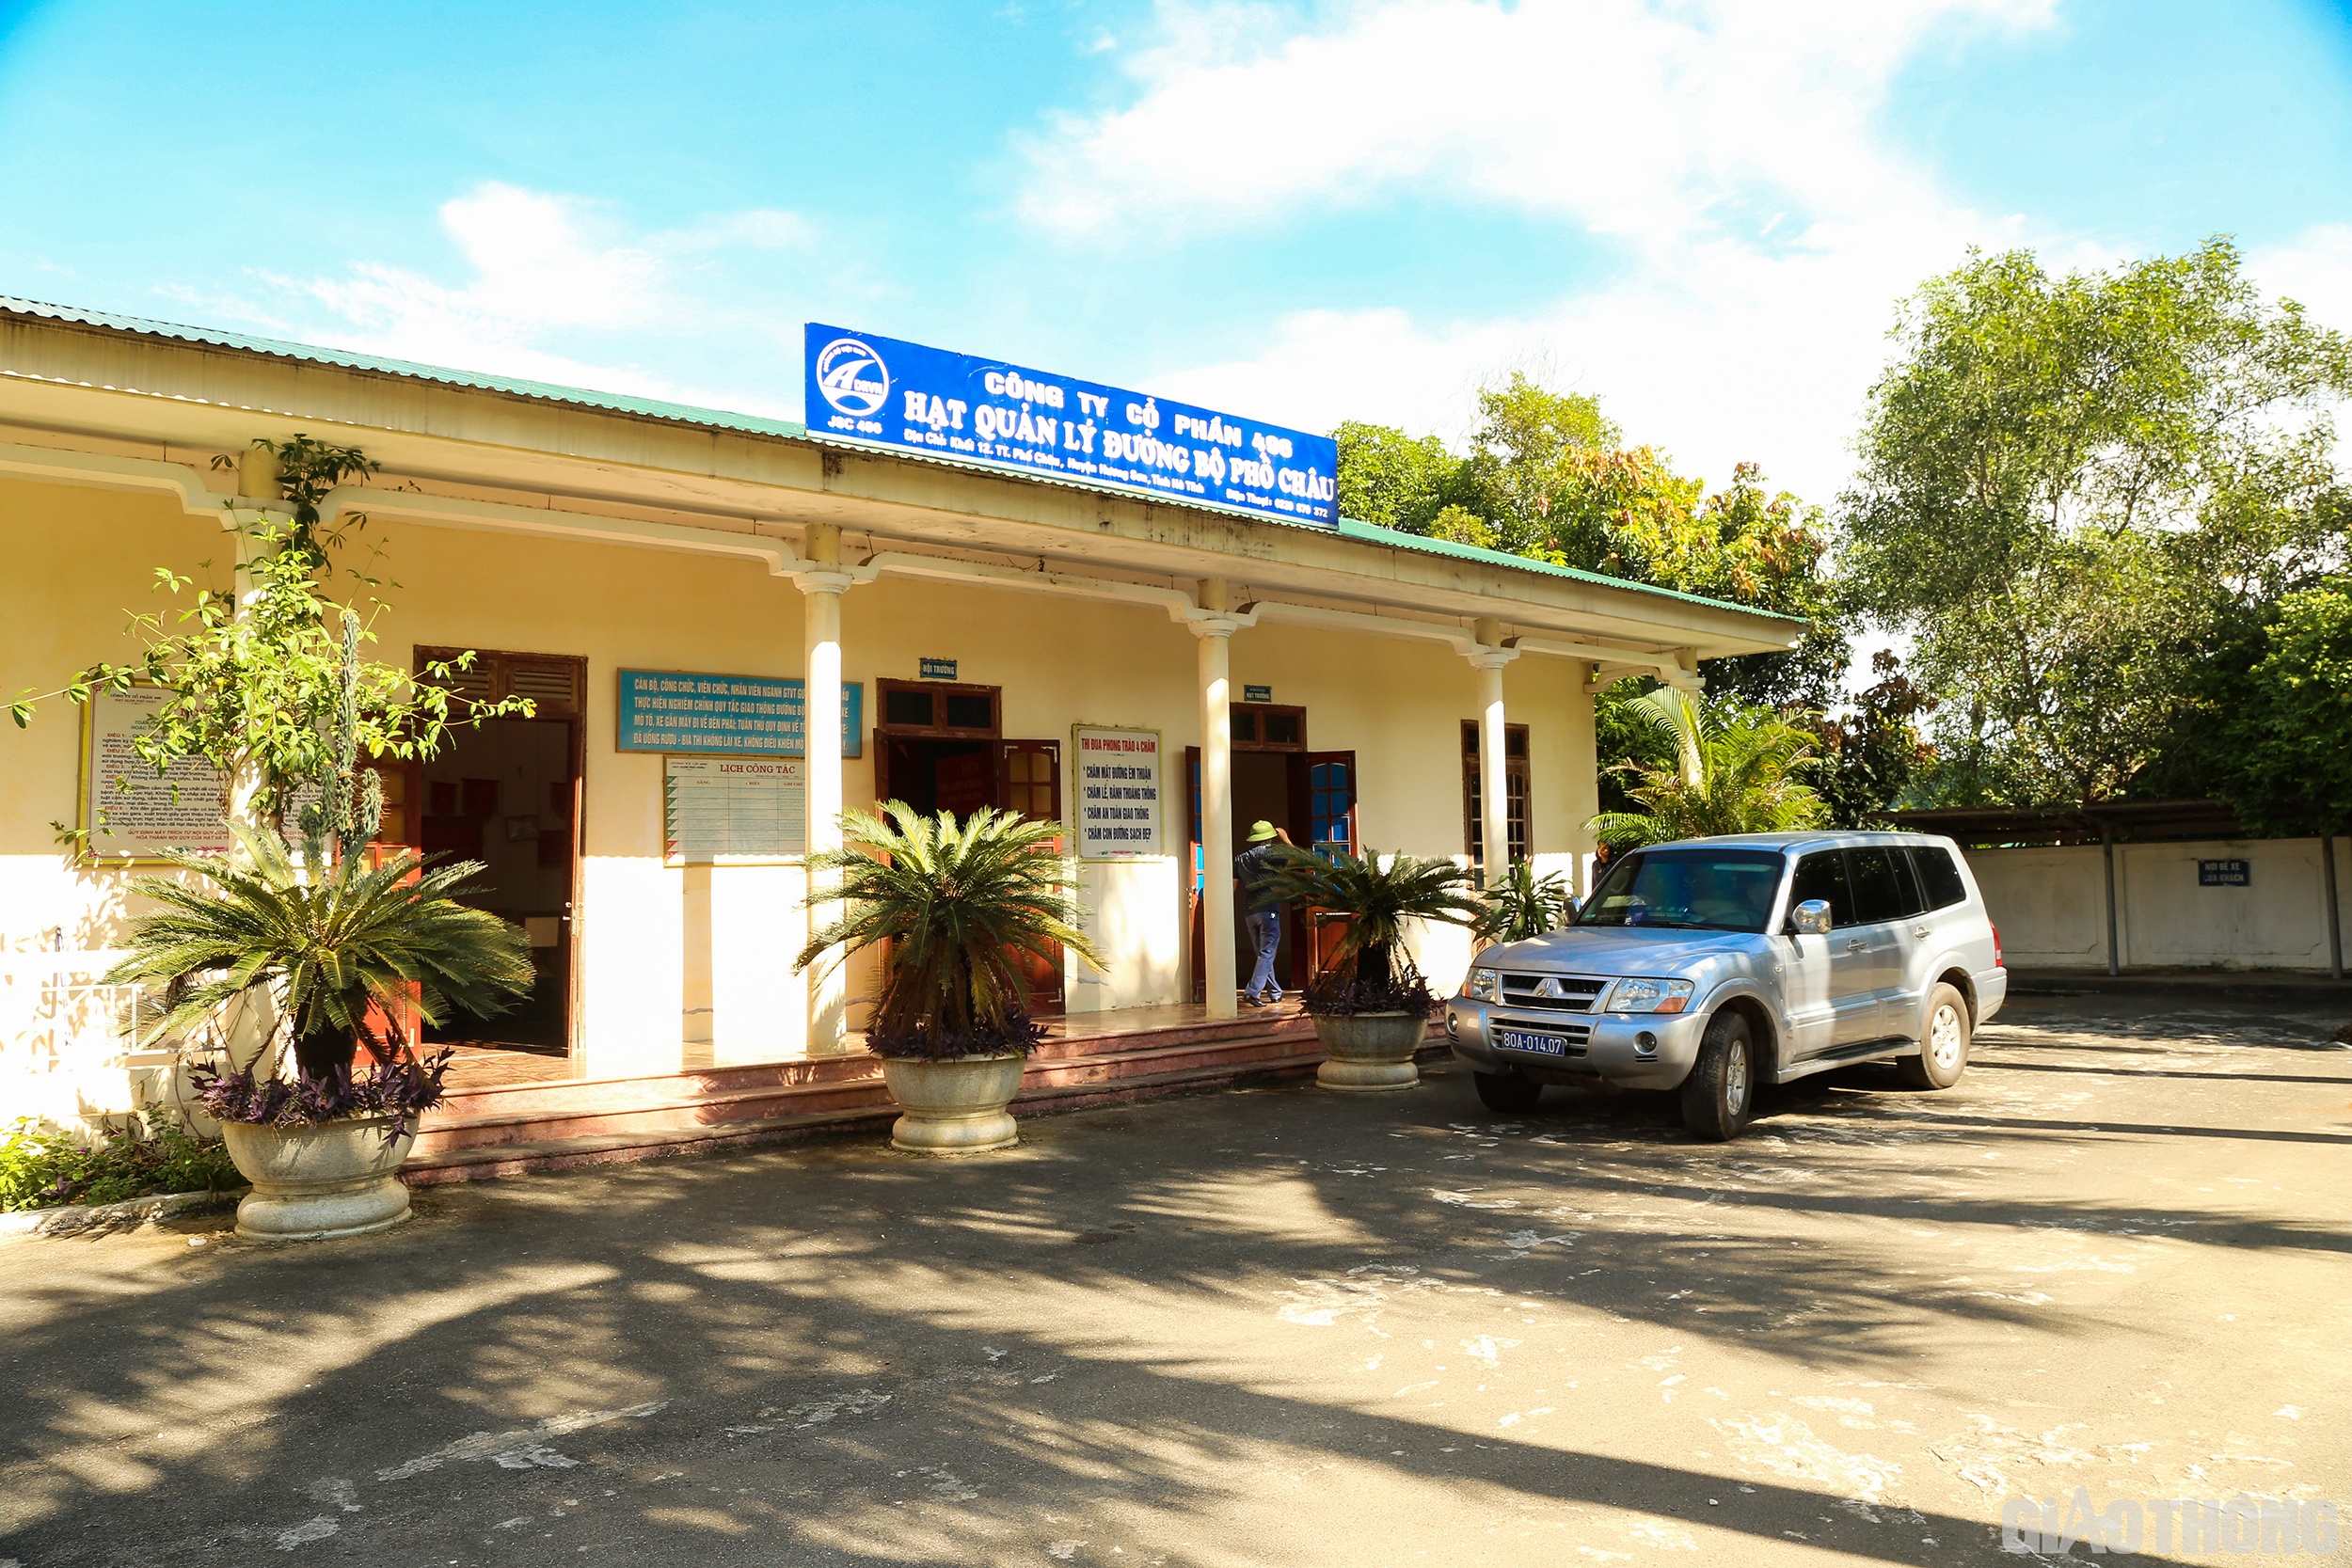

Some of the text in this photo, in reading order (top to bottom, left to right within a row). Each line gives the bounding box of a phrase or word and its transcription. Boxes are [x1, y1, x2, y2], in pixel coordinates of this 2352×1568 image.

[827, 415, 855, 431] JSC
[984, 371, 1293, 459] CÔNG TY CỔ PHẦN 496
[903, 389, 967, 431] HẠT
[974, 402, 1057, 447] QUẢN
[1062, 418, 1097, 454] LÝ
[1103, 428, 1191, 473] ĐƯỜNG
[1192, 447, 1226, 486] BỘ
[1277, 465, 1335, 502] CHÂU
[1313, 506, 1328, 518] 372
[635, 676, 648, 691] CÁN
[649, 677, 659, 694] BỘ,
[660, 678, 677, 692] CÔNG
[678, 678, 696, 694] CHỨC,
[698, 681, 711, 694] VIÊN
[712, 681, 730, 696] CHỨC,
[731, 682, 747, 696] NHÂN
[748, 684, 761, 697] VIÊN
[763, 685, 782, 698] NGÀNH
[783, 688, 797, 699] GTVT
[635, 696, 651, 711] THỰC
[652, 696, 667, 712] HIỆN
[668, 697, 693, 710] NGHIÊM
[715, 701, 727, 713] QUY
[741, 703, 755, 714] GIAO
[756, 702, 775, 714] THÔNG
[776, 702, 796, 715] ĐƯỜNG
[634, 713, 644, 726] MÔ
[656, 716, 664, 727] XE
[679, 715, 692, 728] MÁY
[709, 716, 720, 729] BÊN
[738, 717, 752, 731] TUÂN
[754, 716, 764, 731] THỦ
[765, 721, 777, 732] QUY
[777, 721, 791, 734] ĐỊNH
[661, 733, 677, 747] RƯỢU
[682, 734, 692, 746] BIA
[703, 733, 723, 747] KHÔNG
[724, 734, 733, 747] LÁI
[734, 736, 743, 748] XE,
[744, 735, 763, 748] KHÔNG
[795, 737, 804, 749] MÔ
[1081, 738, 1155, 752] THI ĐUA PHONG TRÀO 4 CHĂM
[720, 763, 795, 774] LỊCH CÔNG TÁC
[1086, 764, 1100, 778] CHĂM
[1112, 764, 1127, 779] ĐƯỜNG
[1129, 765, 1136, 779] ÊM
[1136, 765, 1151, 783] THUẬN
[1087, 784, 1101, 799] CHĂM
[1141, 786, 1156, 800] THÔNG
[1088, 805, 1149, 820] CHĂM AN TOÀN GIAO THÔNG
[1088, 825, 1152, 842] CHĂM CON ĐƯỜNG SẠCH ĐẸP
[1504, 1032, 1561, 1053] 80A-014.07
